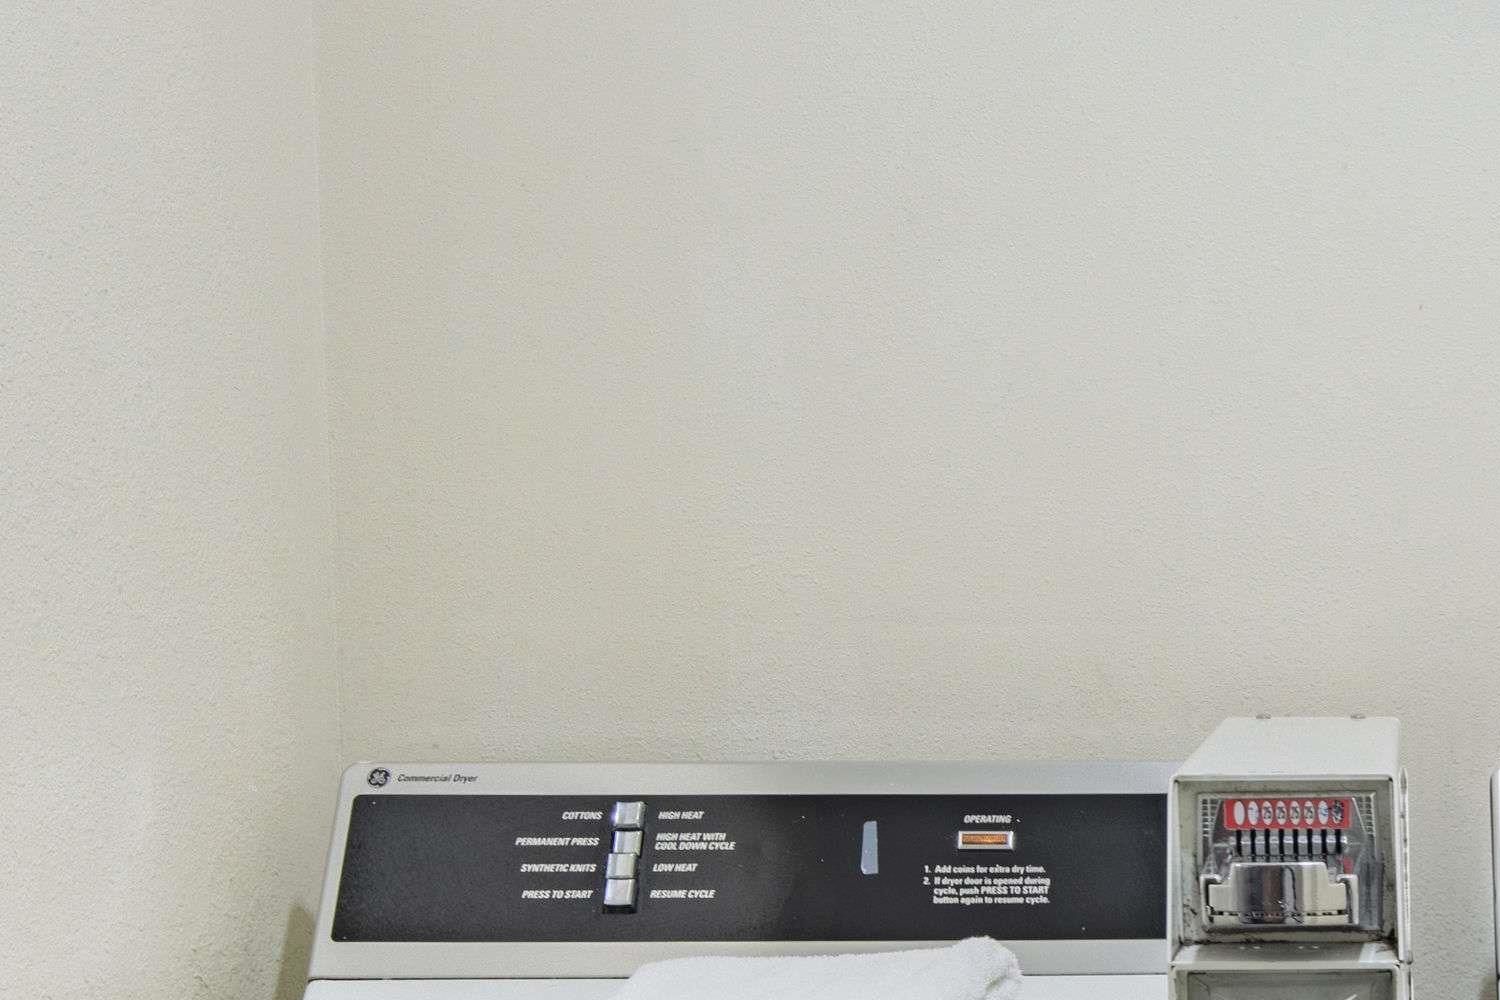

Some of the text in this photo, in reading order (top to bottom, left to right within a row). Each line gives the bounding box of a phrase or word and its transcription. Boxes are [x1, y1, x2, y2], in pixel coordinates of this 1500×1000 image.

[398, 774, 478, 784] Commercial Dryer
[562, 812, 603, 820] COTTONS
[658, 811, 704, 820] HIGH HEAT
[964, 815, 1012, 823] OPERATING
[656, 833, 726, 841] HIGH HEAT WITH
[515, 838, 600, 846] PERMANENT PRESS
[654, 842, 736, 851] COOL DOWN CYCLE
[520, 864, 597, 872] SYNTHETIC KNITS
[652, 863, 698, 872] LOW HEAT
[935, 865, 951, 873] Add
[953, 865, 975, 873] coins
[976, 865, 988, 873] for
[989, 865, 1010, 873] extra
[1011, 865, 1024, 875] dry
[923, 877, 1051, 886] 2. If dryer door is opened during
[521, 890, 594, 899] PRESS TO START
[650, 890, 716, 899] RESUME CYCLE
[933, 886, 1049, 896] cycle, push PRESS TO START
[933, 896, 959, 904] button
[960, 896, 983, 905] again
[984, 896, 993, 904] to
[1025, 896, 1050, 905] cycle.
